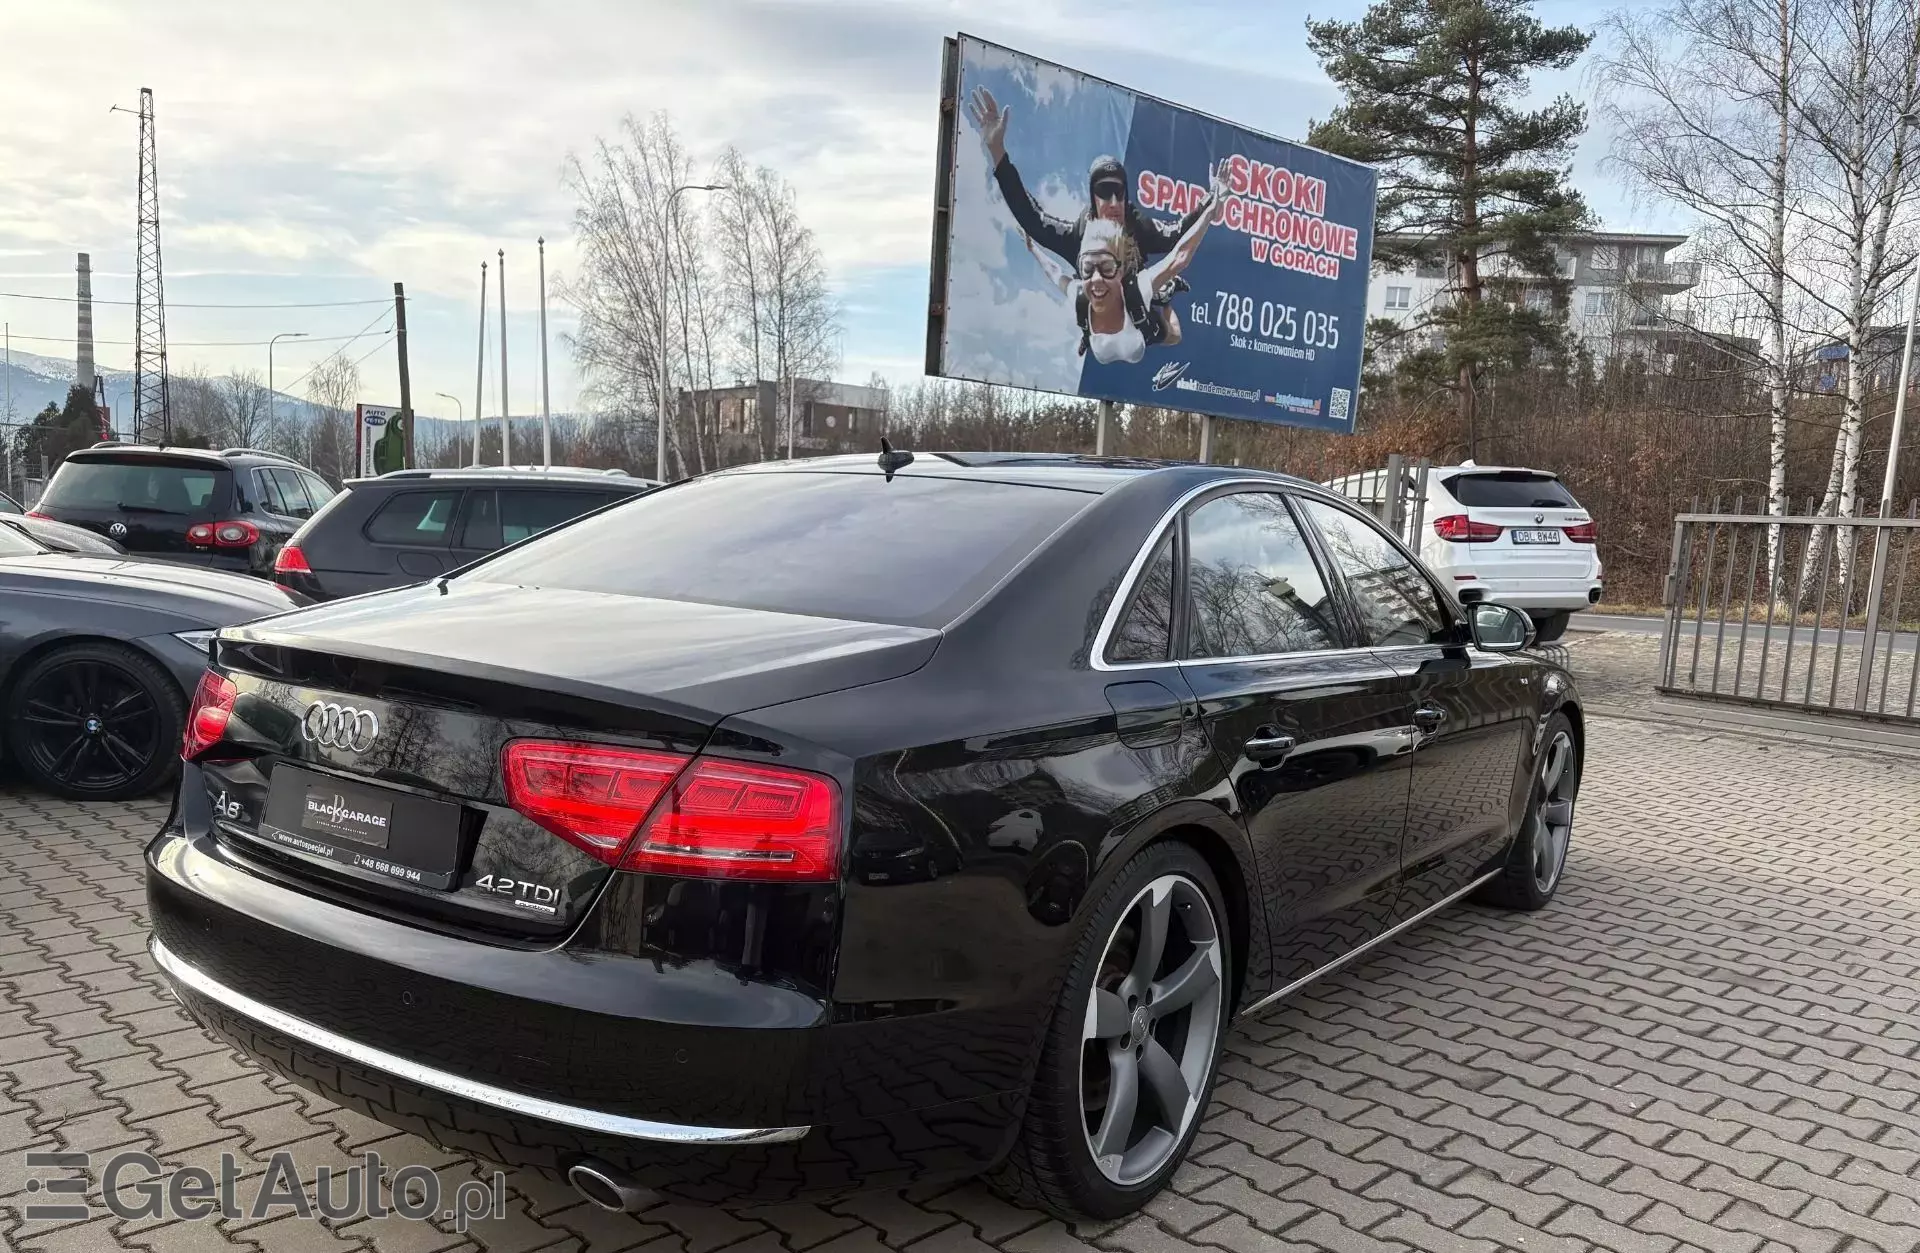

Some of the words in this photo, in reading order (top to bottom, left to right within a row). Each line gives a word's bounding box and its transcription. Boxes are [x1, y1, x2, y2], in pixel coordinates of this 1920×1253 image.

[1228, 154, 1326, 217] SKOKI
[1251, 237, 1269, 262] W
[1270, 241, 1339, 280] GÓRACH
[1191, 302, 1211, 325] tel.
[1216, 290, 1253, 332] 788
[1260, 301, 1297, 341] 025
[1303, 310, 1339, 349] 035
[1230, 334, 1246, 348] Skok
[1248, 340, 1253, 350] z
[1254, 339, 1304, 359] kamerowaniem
[1305, 349, 1316, 361] HD
[1518, 531, 1535, 542] DBL
[215, 790, 240, 819] A8
[278, 833, 334, 857] www.autospecjal.pl
[361, 858, 375, 869] +48
[375, 861, 390, 873] 668
[390, 865, 405, 877] 699
[406, 870, 421, 881] 944
